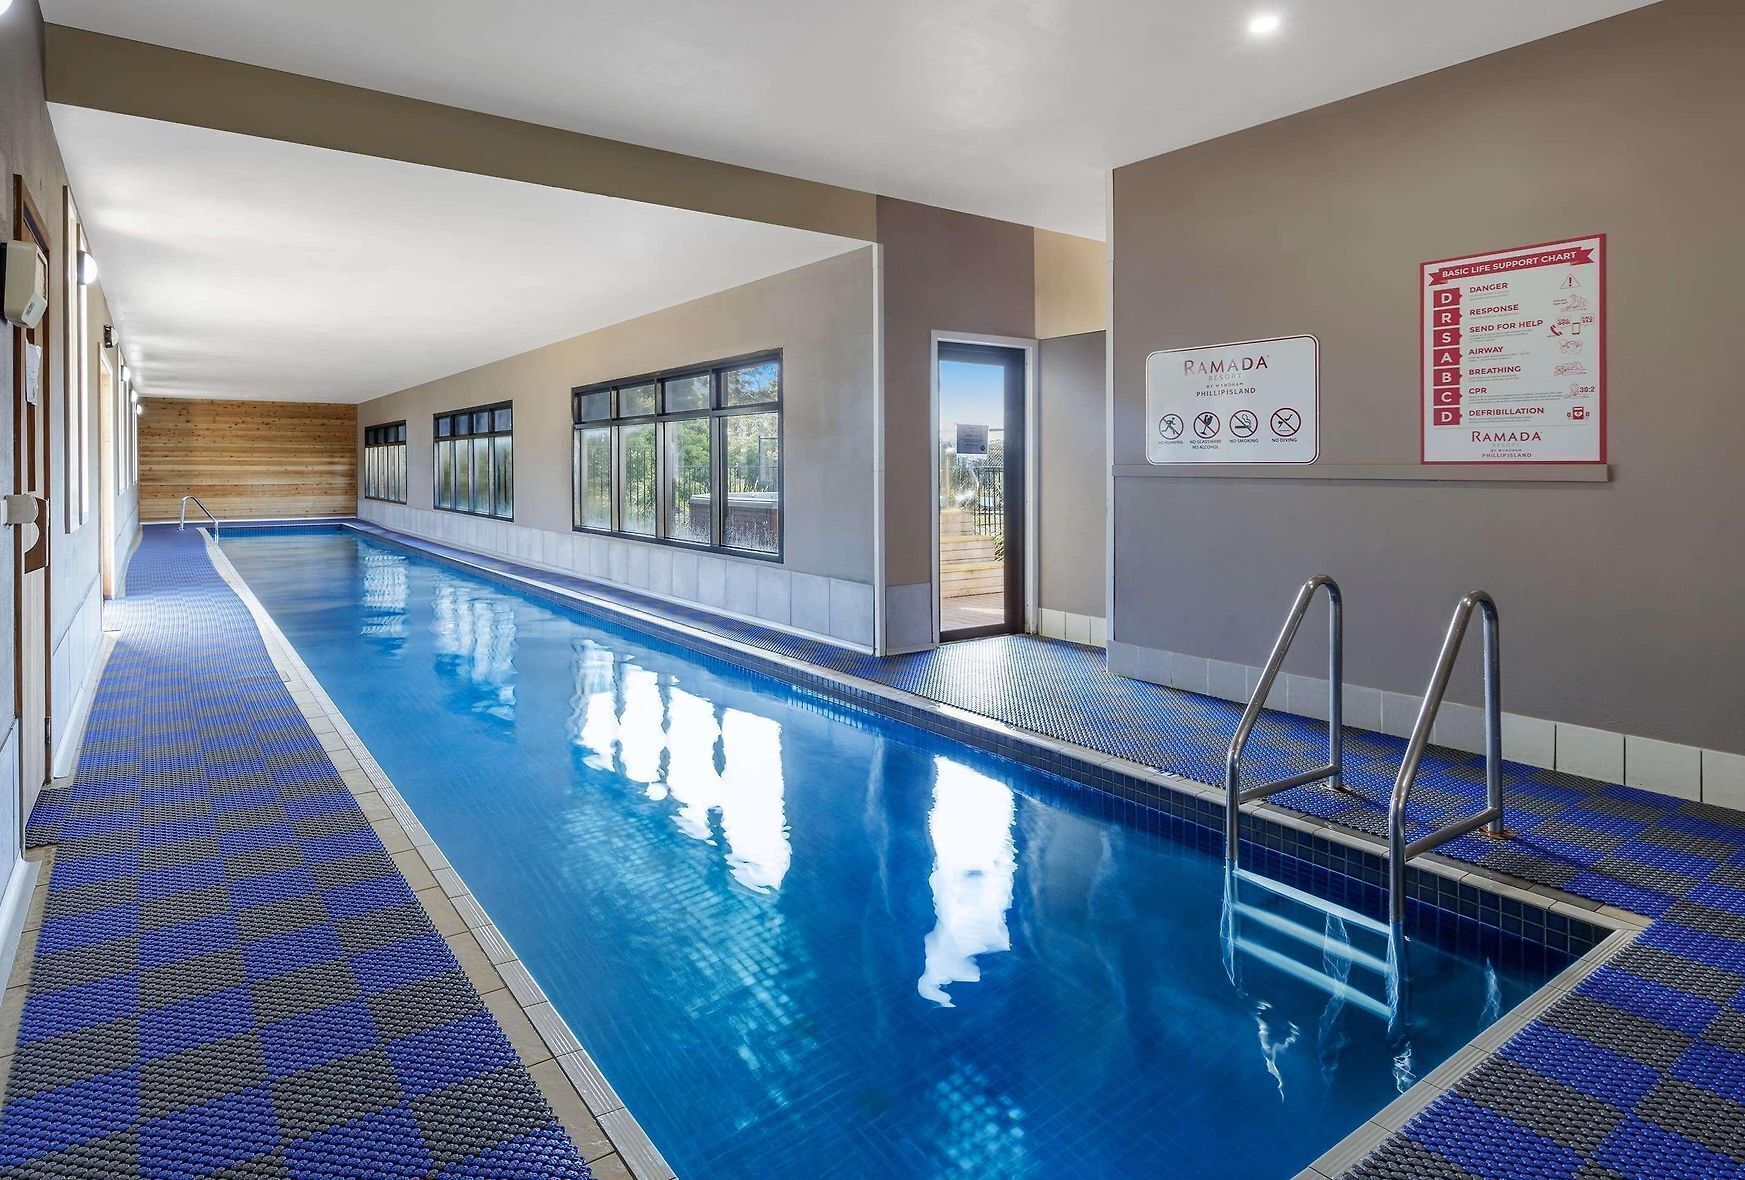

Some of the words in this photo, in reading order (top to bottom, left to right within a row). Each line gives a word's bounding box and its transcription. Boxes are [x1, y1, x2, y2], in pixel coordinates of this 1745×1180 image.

[1442, 267, 1469, 278] BASIC
[1471, 264, 1491, 274] LIFE
[1493, 257, 1538, 270] SUPPORT
[1541, 251, 1577, 263] CHART
[1469, 282, 1508, 293] DANGER
[1441, 293, 1452, 304] D
[1469, 304, 1519, 315] RESPONSE
[1441, 313, 1452, 324] R
[1469, 325, 1495, 333] SEND
[1497, 322, 1516, 331] FOR
[1518, 319, 1544, 328] HELP
[1441, 333, 1452, 343] S
[1468, 346, 1504, 355] AIRWAY
[1440, 352, 1453, 364] A
[1184, 355, 1268, 376] RAMADA
[1468, 365, 1521, 375] BREATHING
[1208, 373, 1242, 381] RESORT
[1441, 372, 1452, 383] B
[1468, 387, 1487, 395] CPR
[1441, 392, 1452, 403] C
[1441, 412, 1452, 422] D
[1468, 407, 1544, 417] DEFRIBILLATION
[1472, 430, 1542, 442] RAMADA
